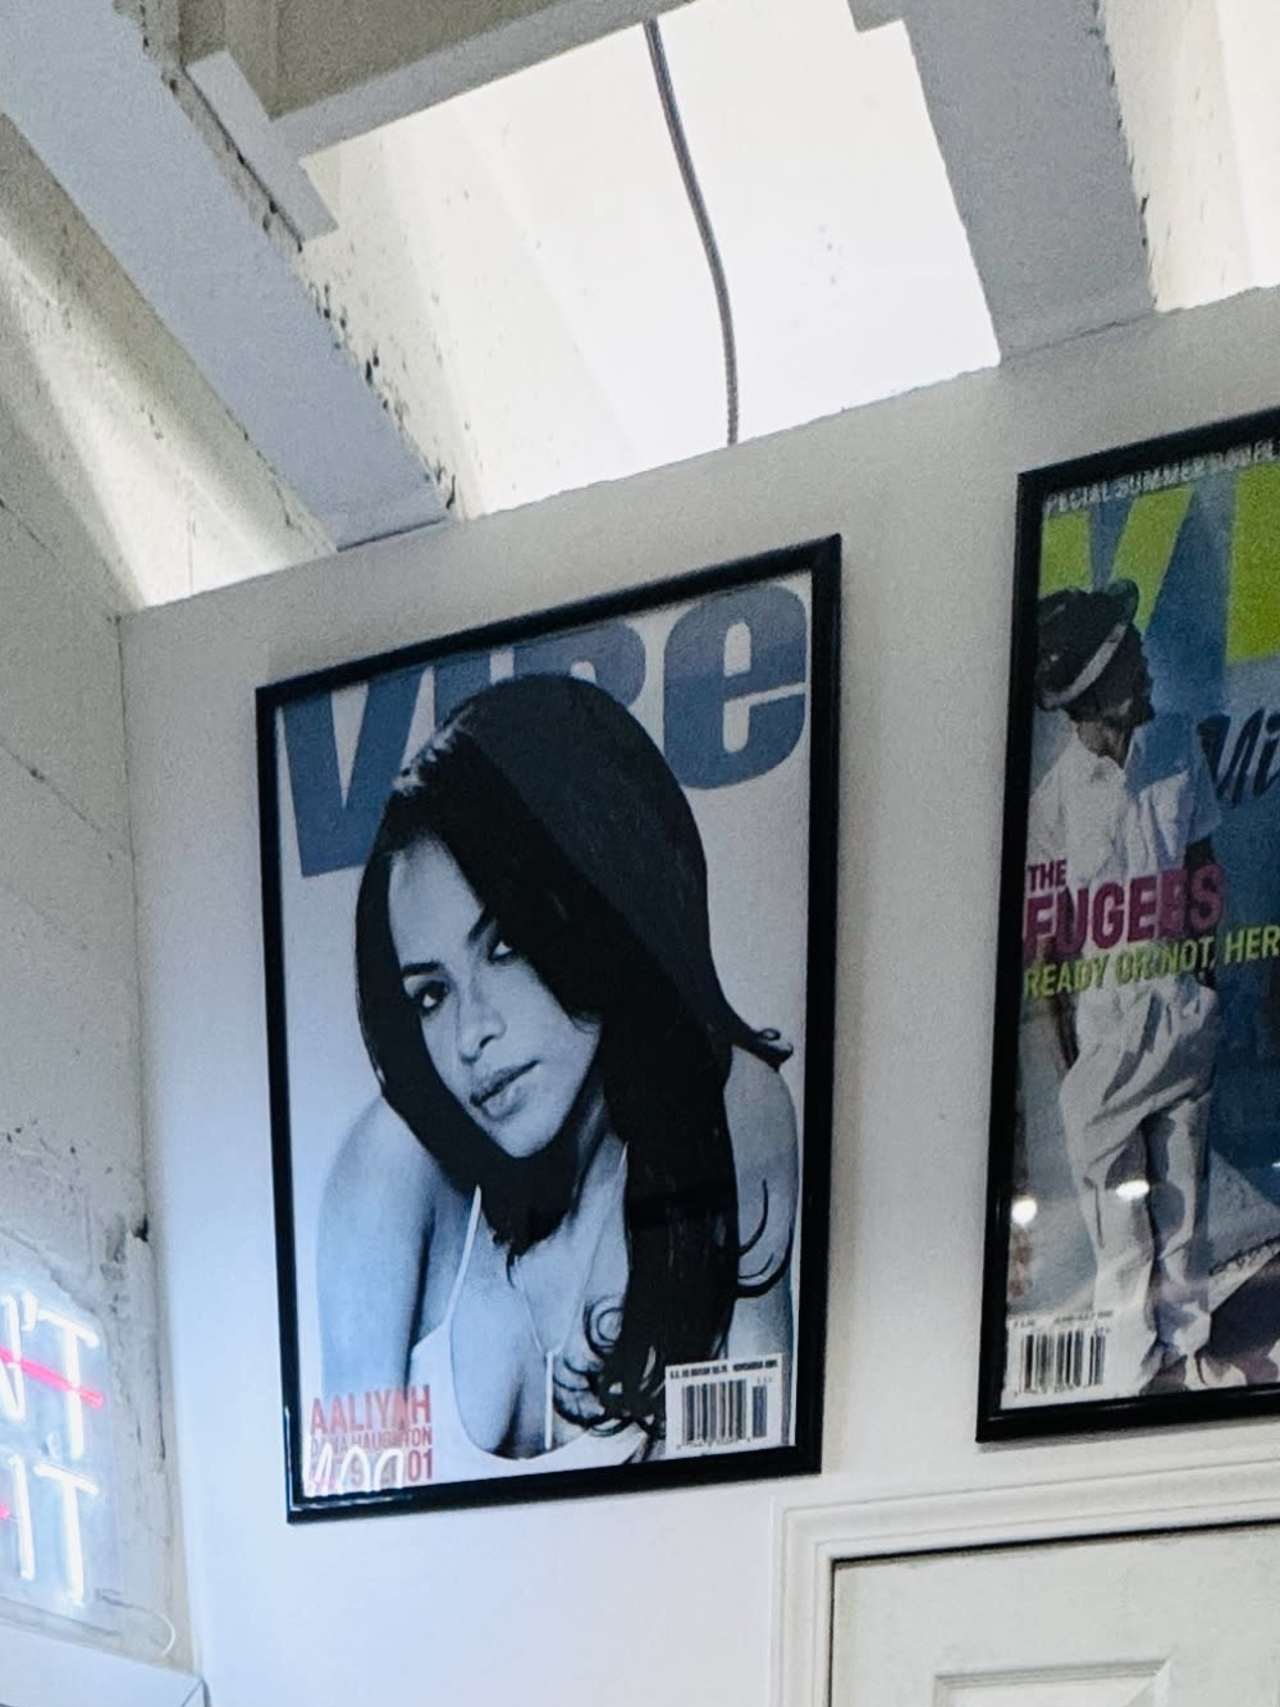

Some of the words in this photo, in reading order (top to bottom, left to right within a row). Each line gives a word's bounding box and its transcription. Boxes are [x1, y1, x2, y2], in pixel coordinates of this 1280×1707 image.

[1027, 858, 1067, 894] THE
[1023, 863, 1227, 968] FUGEES
[1023, 955, 1110, 1000] READY
[1116, 948, 1154, 986] OR
[310, 1384, 431, 1435] AALIYAH
